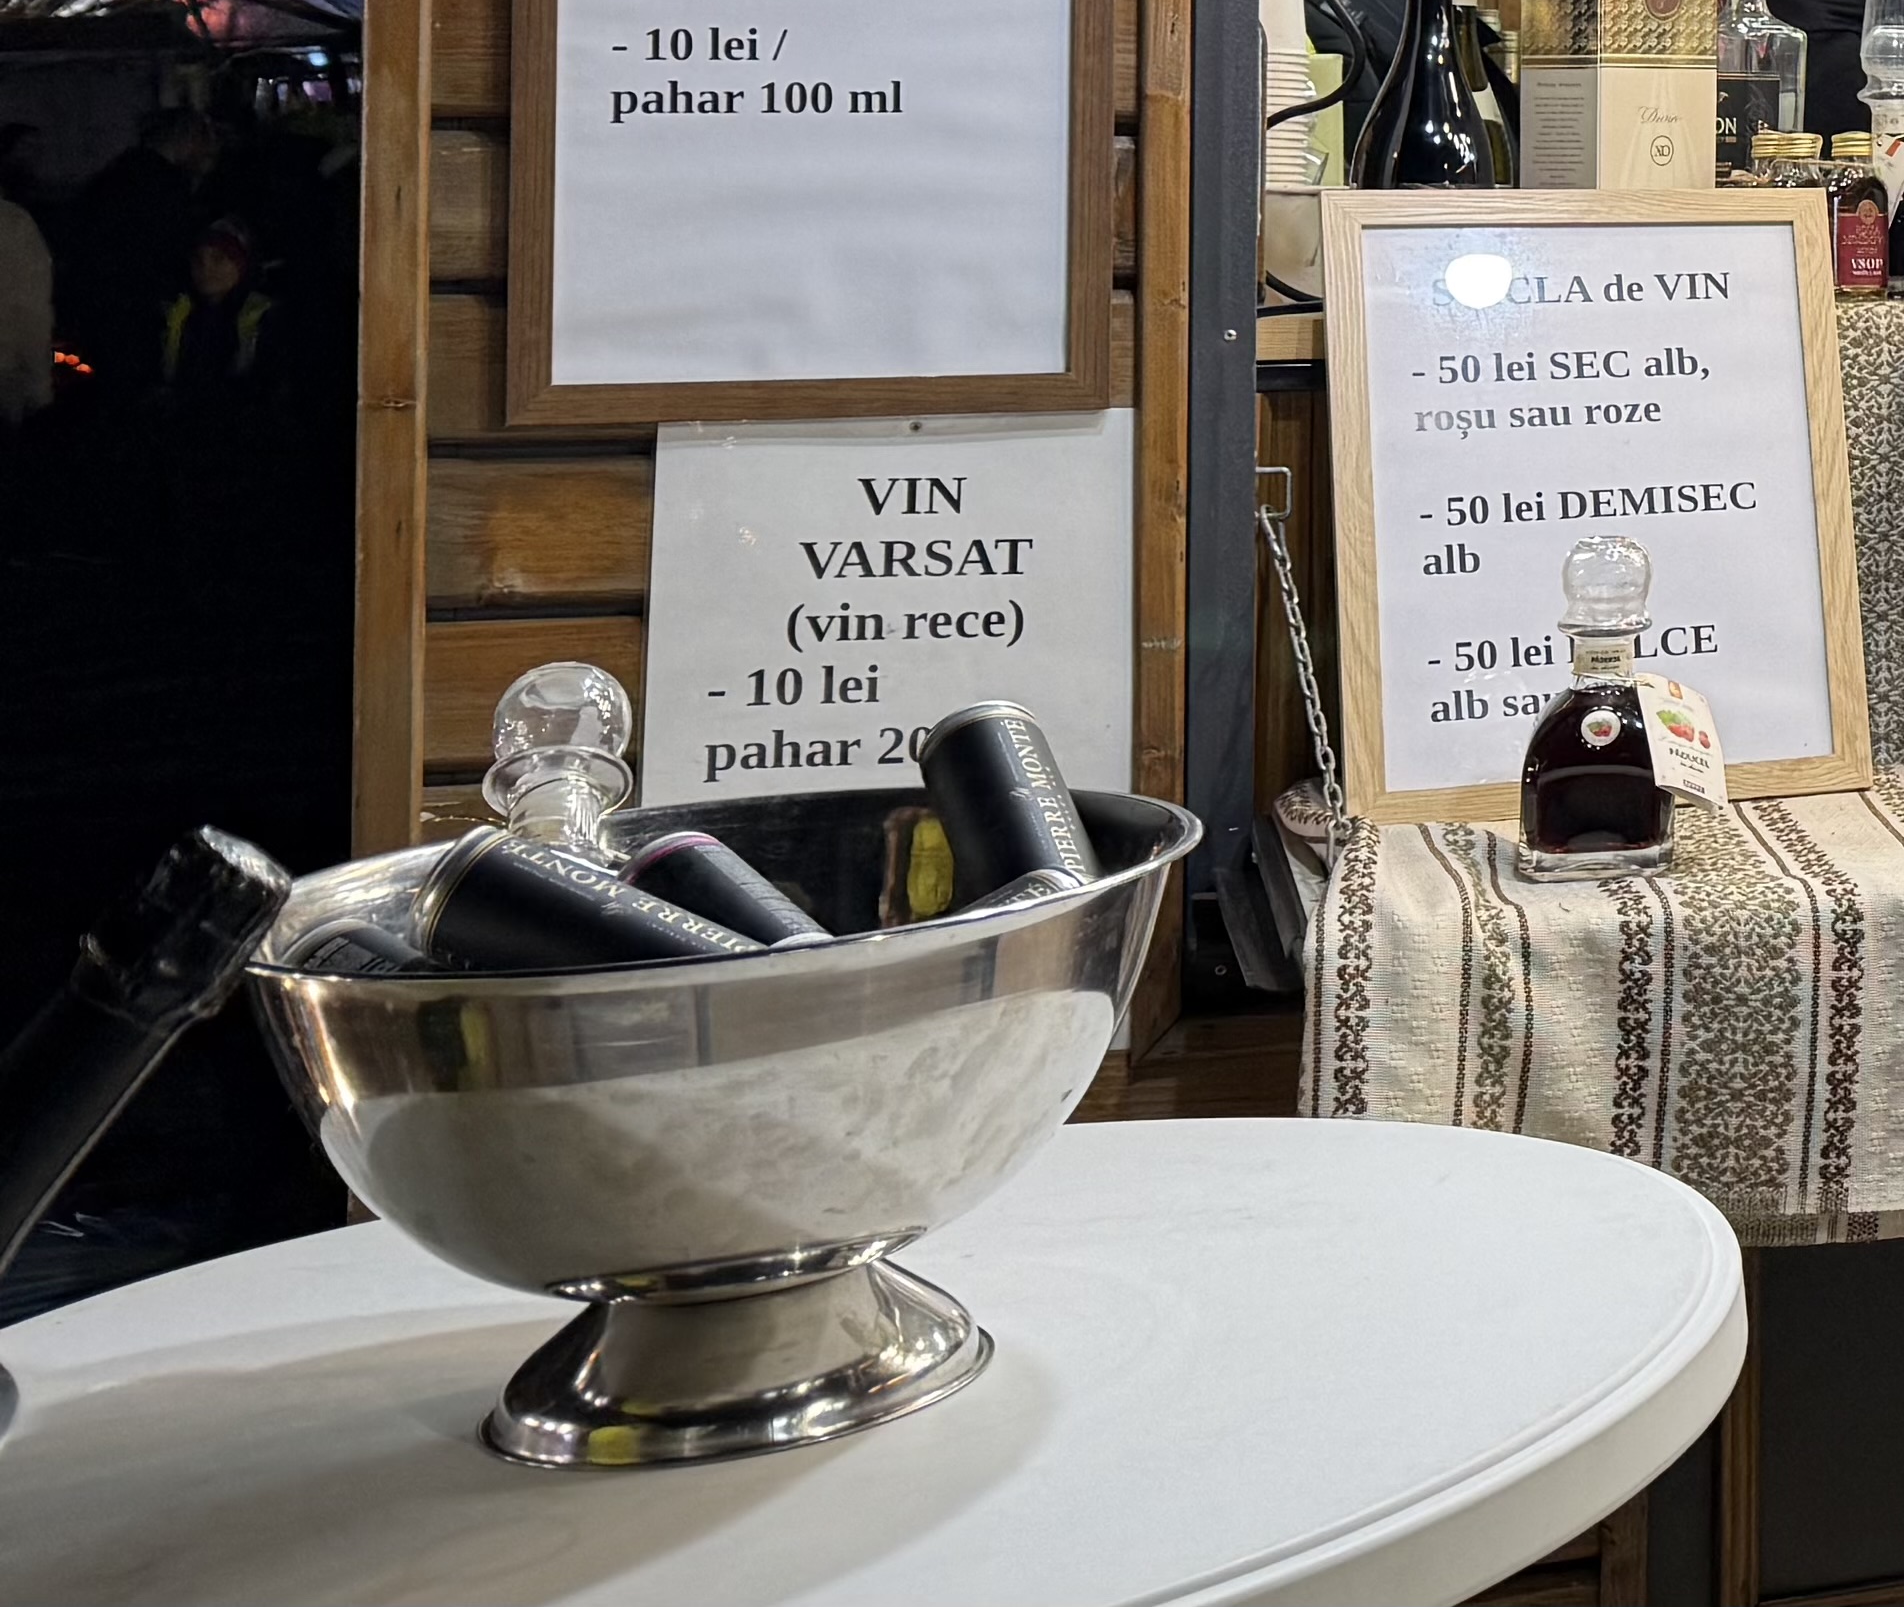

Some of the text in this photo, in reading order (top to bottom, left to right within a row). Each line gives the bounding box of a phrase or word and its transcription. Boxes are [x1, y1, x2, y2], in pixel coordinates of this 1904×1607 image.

[645, 26, 760, 61] 10 lei
[609, 80, 903, 124] pahar 100 ml
[1432, 271, 1730, 305] SCLA de VIN
[1438, 346, 1710, 384] 50 lei SEC alb,
[1509, 406, 1572, 428] sau
[1584, 402, 1662, 425] roze
[857, 476, 968, 516] VIN
[1446, 481, 1757, 527] 50 lei DEMISEC
[798, 538, 1034, 580] VARSAT
[1422, 543, 1481, 576] alb
[787, 599, 1024, 654] (vin rece)
[1454, 624, 1718, 672] 50 lei LCE
[746, 664, 880, 707] 10 lei
[1430, 689, 1489, 723] alb
[702, 729, 862, 784] pahar
[1036, 795, 1085, 872] PIERRE
